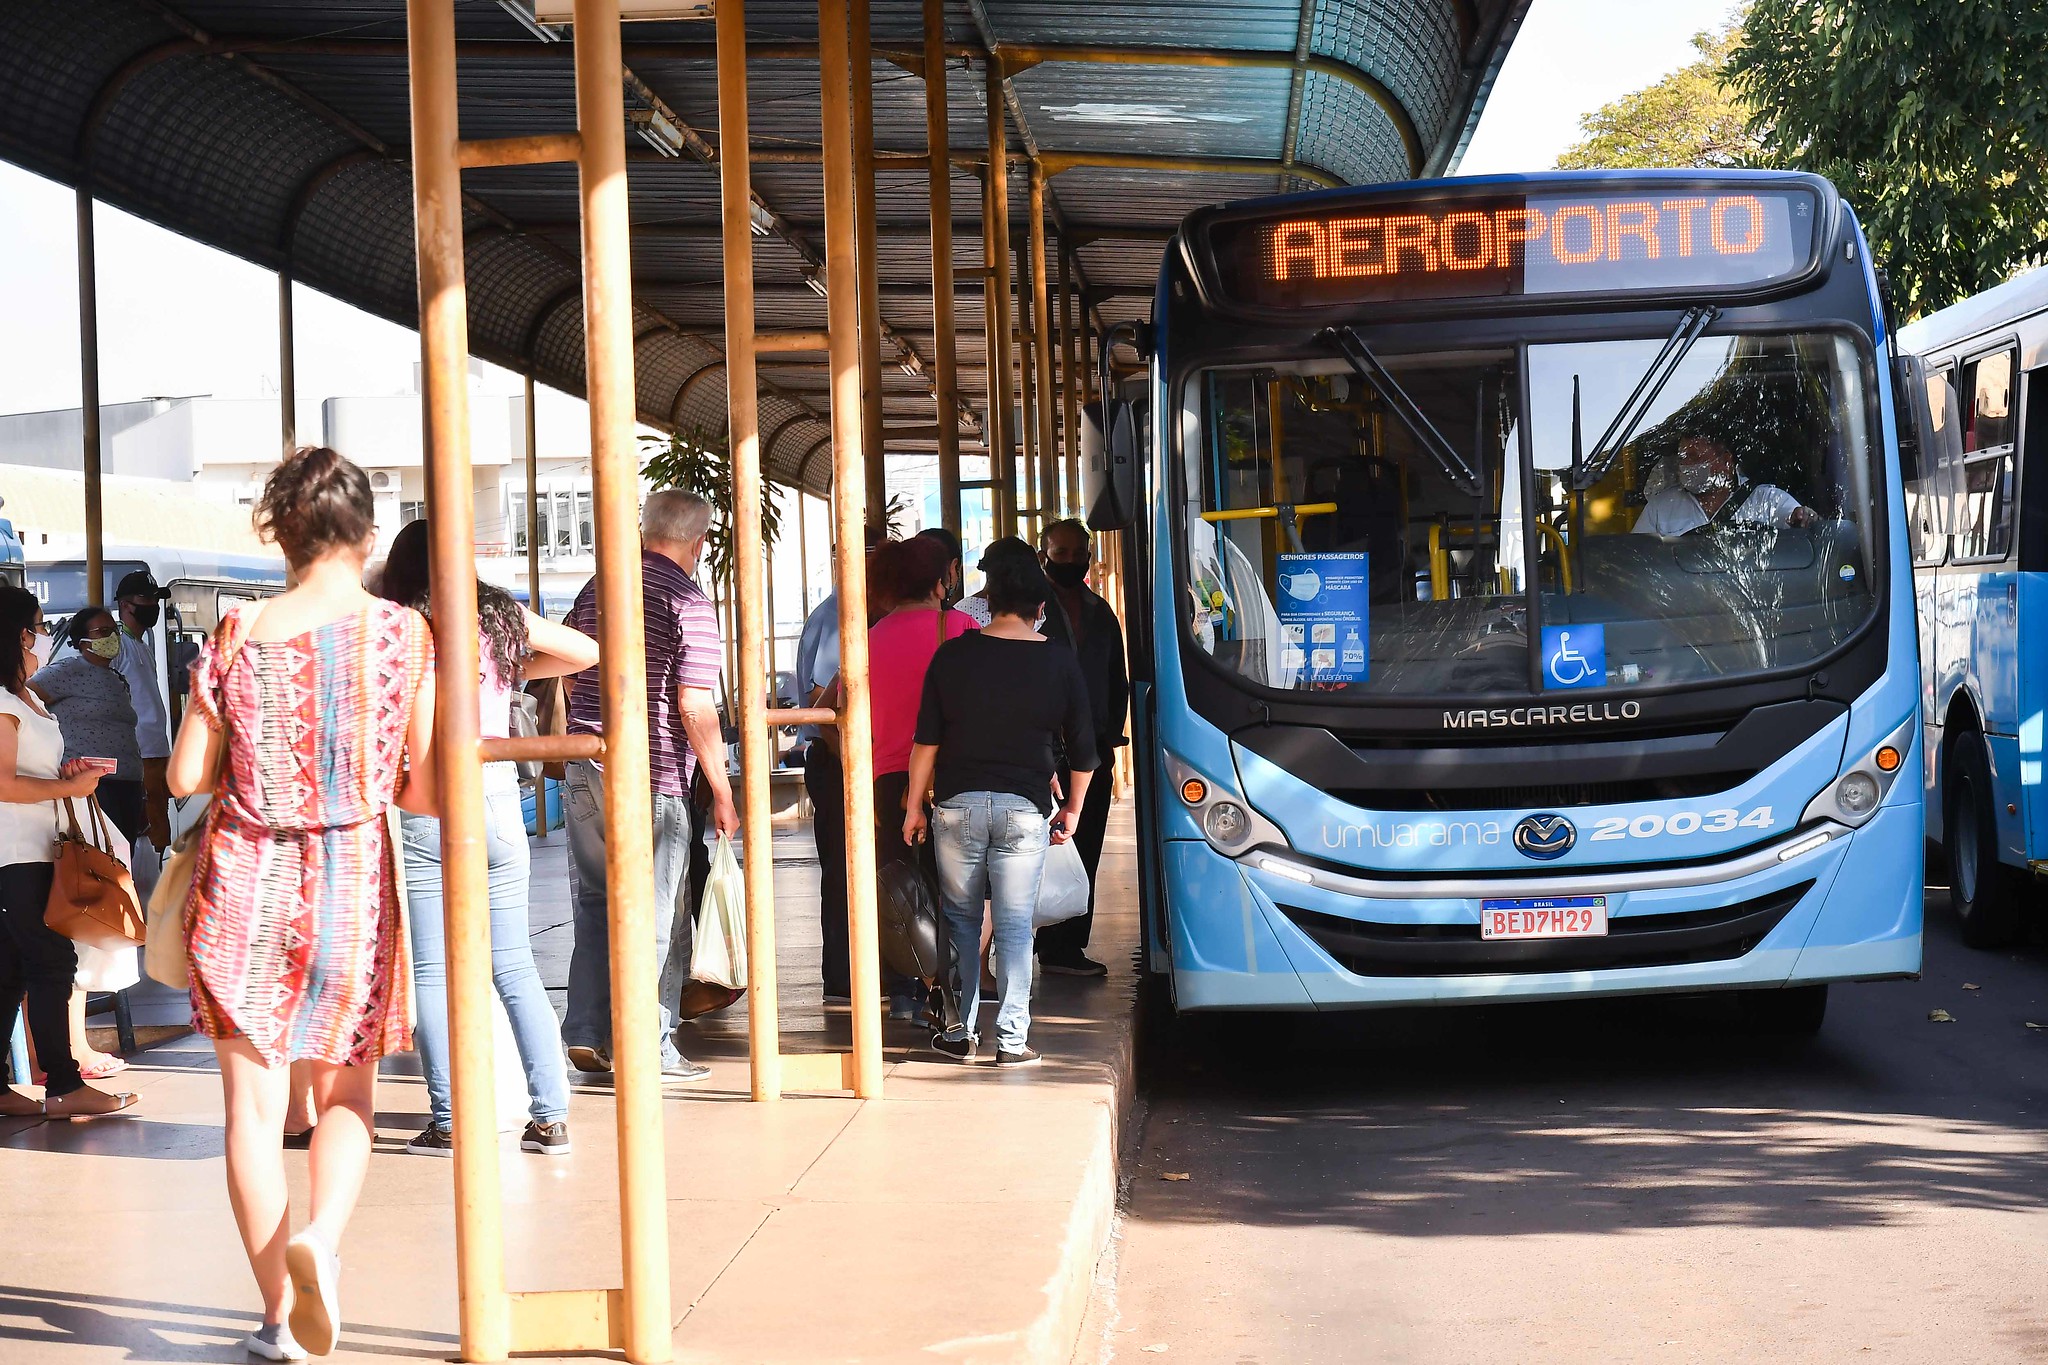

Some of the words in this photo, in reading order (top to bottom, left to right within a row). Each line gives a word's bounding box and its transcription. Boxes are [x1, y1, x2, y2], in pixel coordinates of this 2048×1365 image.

[1272, 195, 1765, 281] AEROPORTO
[1443, 701, 1640, 728] MASCARELLO
[1322, 821, 1500, 848] umuarama
[1590, 806, 1775, 841] 20034
[1493, 910, 1593, 934] BED7H29
